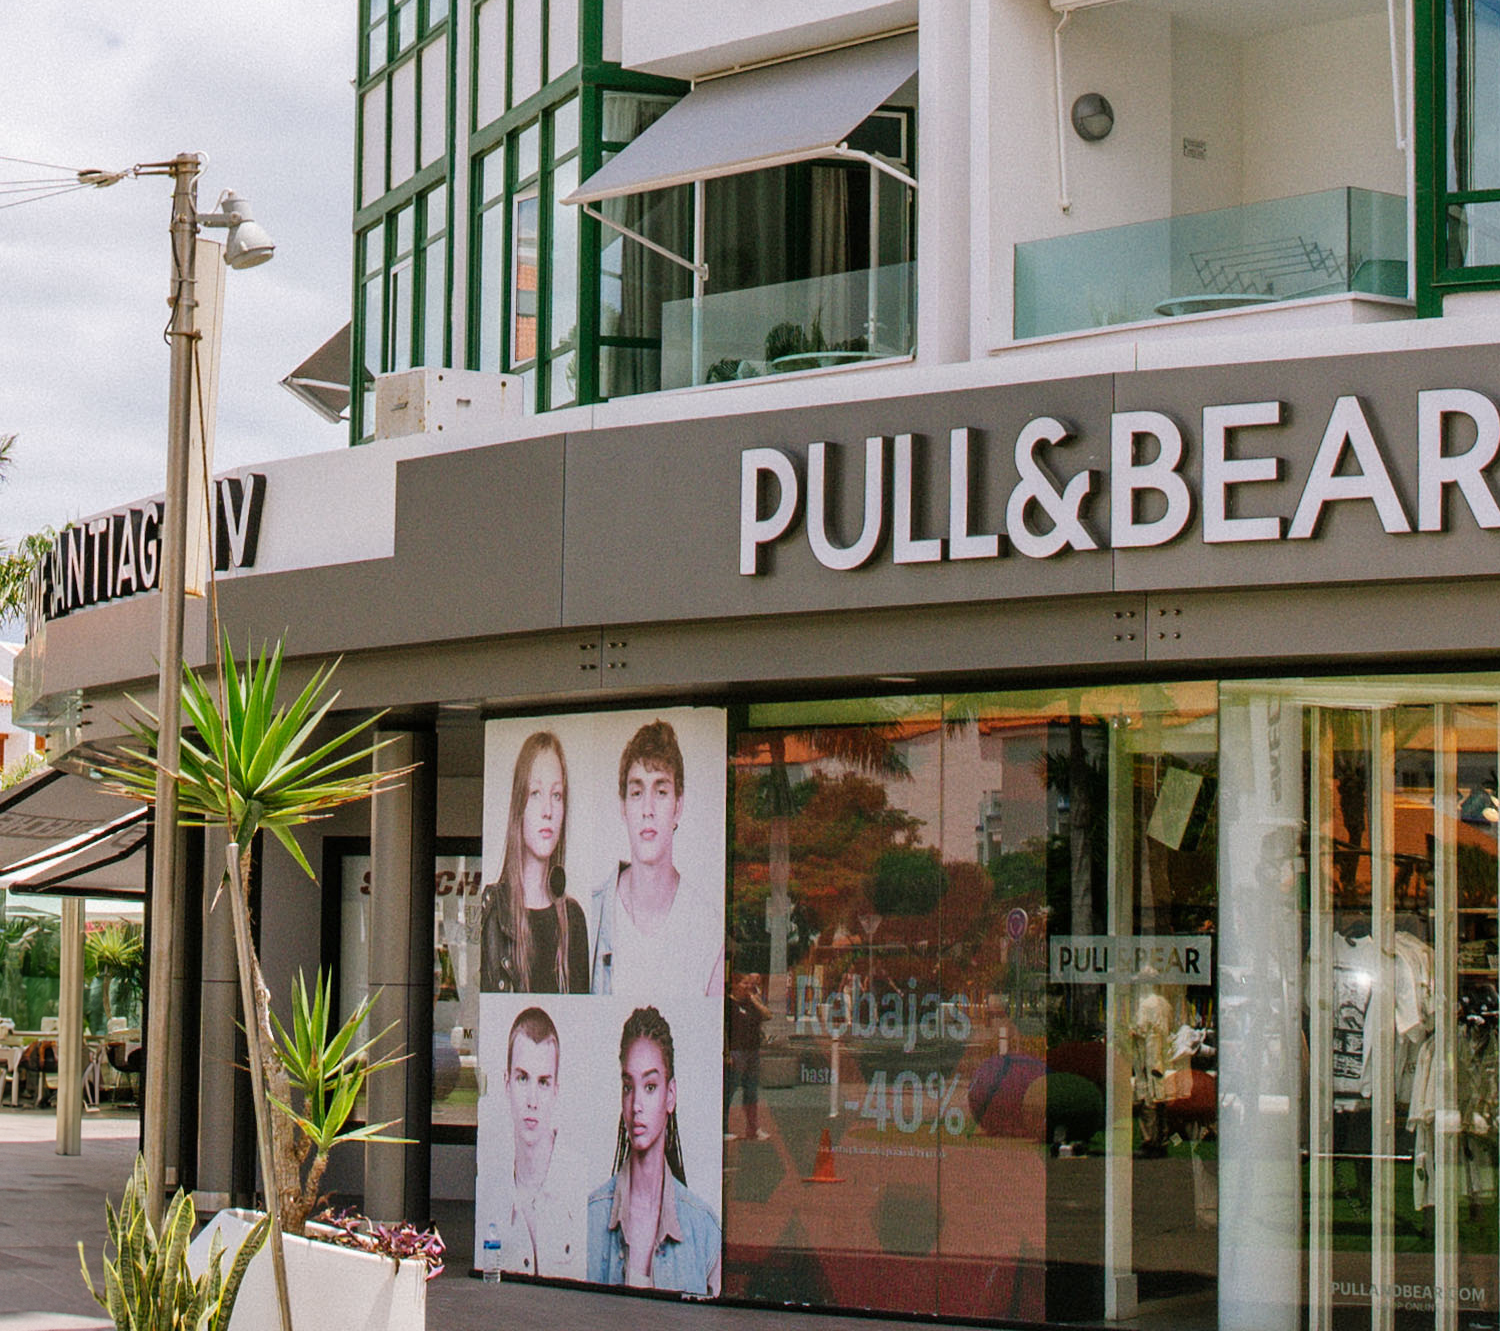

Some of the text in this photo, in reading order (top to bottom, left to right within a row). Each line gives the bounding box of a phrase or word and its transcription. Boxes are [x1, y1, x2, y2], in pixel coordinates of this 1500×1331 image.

[795, 974, 972, 1053] Rebajas
[801, 1064, 839, 1084] hasta
[844, 1070, 965, 1135] -40%
